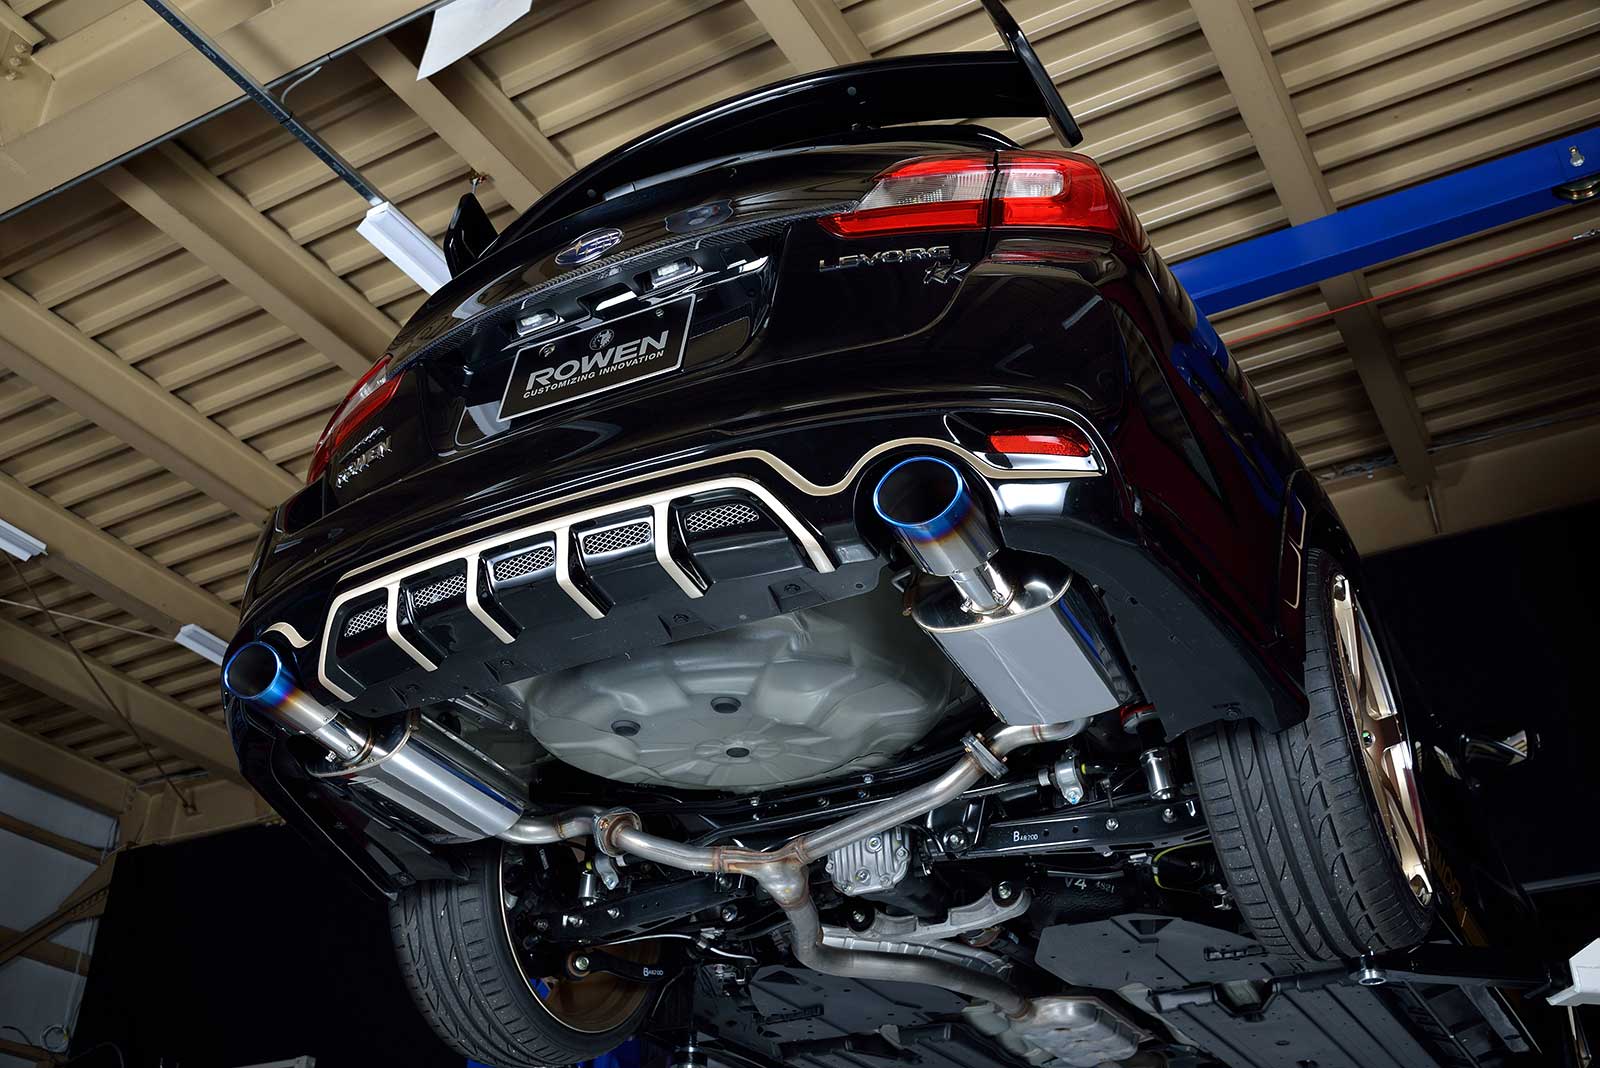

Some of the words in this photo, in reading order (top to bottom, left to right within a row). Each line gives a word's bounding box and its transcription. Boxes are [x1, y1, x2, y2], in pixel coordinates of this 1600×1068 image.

[819, 246, 950, 272] LEVORG
[523, 371, 596, 399] CUSTOMIZING
[599, 350, 664, 376] INNOVATION
[525, 330, 669, 391] ROWEN
